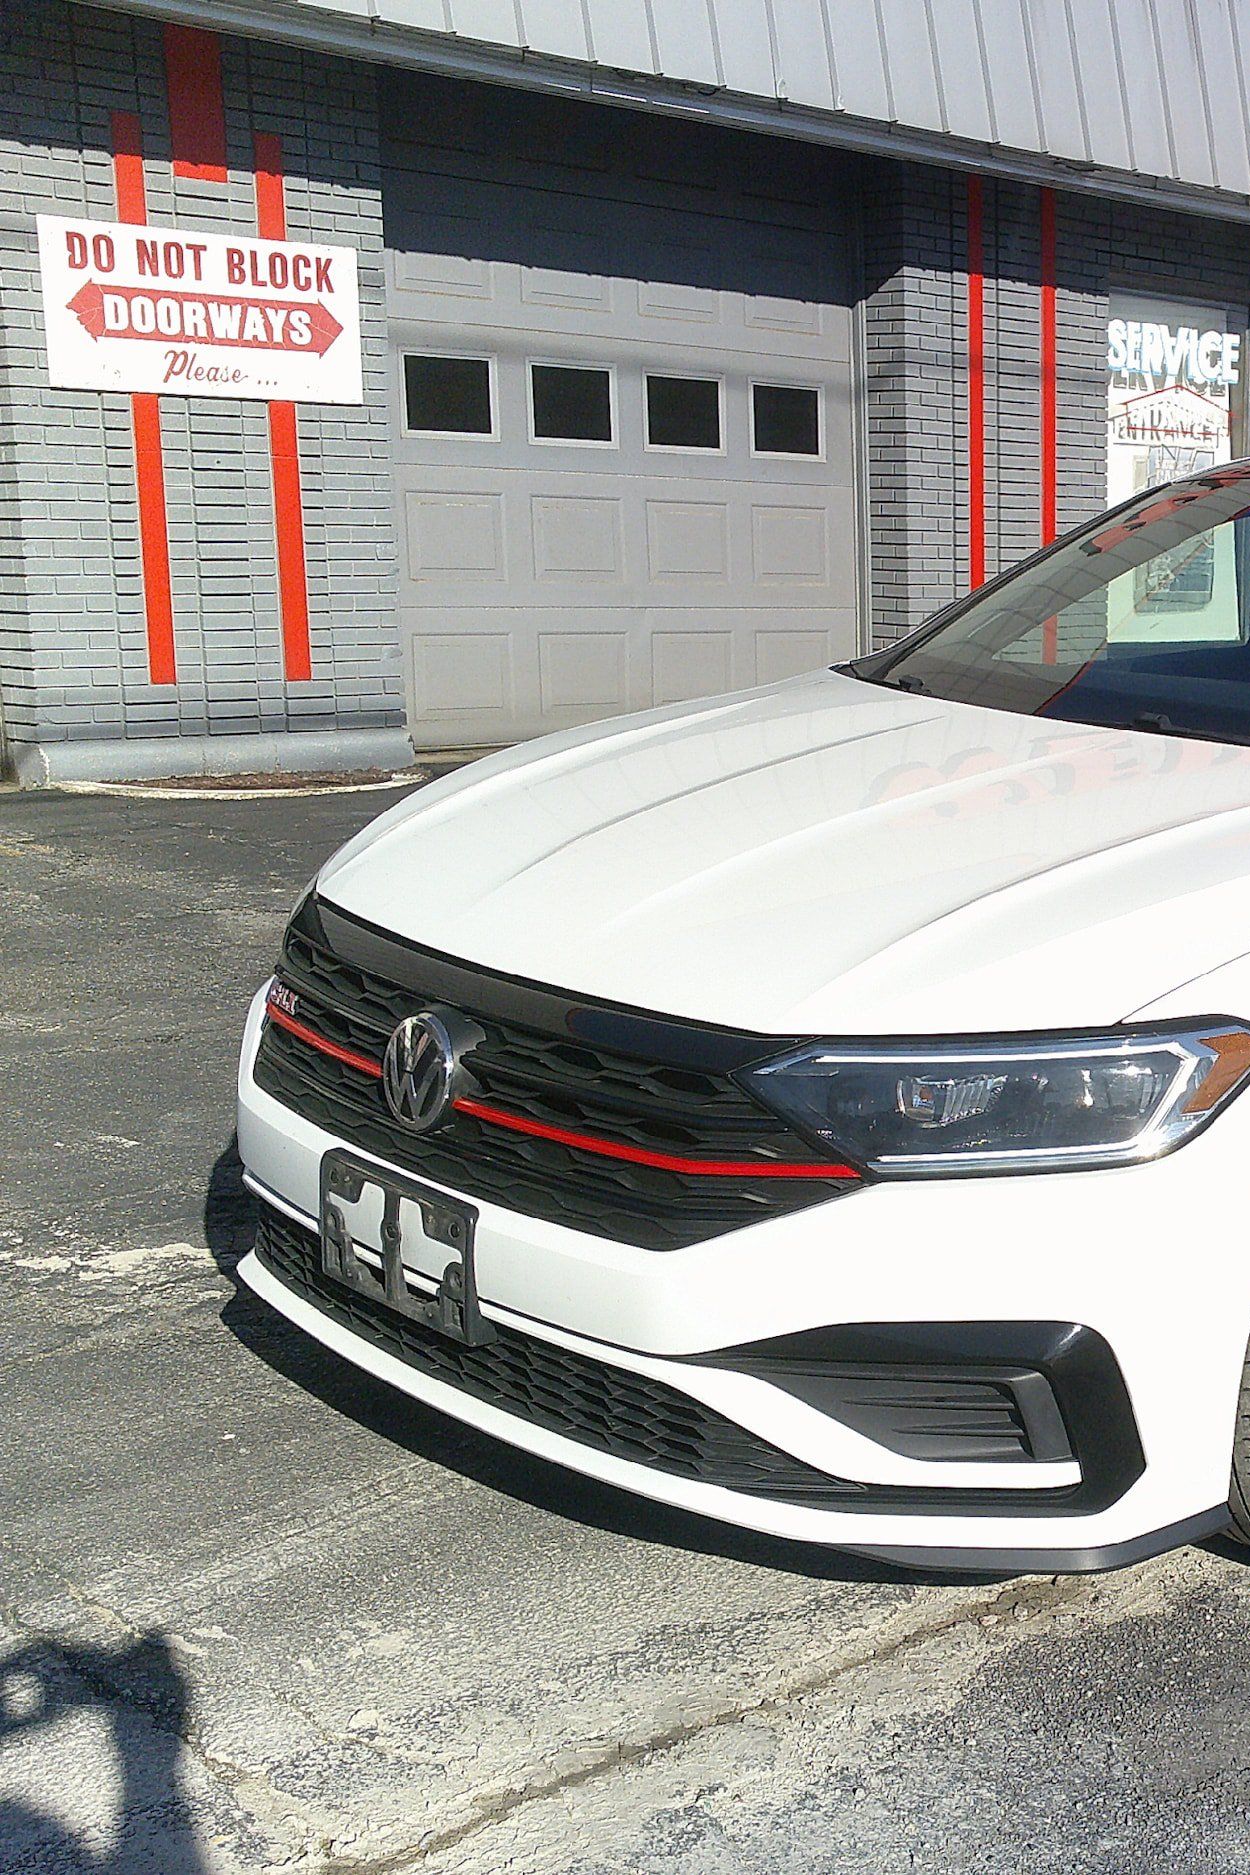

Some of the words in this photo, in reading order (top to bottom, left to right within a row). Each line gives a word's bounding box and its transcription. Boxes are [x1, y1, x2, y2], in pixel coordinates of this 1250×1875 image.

[66, 231, 116, 273] DO
[136, 239, 208, 281] NOT
[227, 248, 335, 294] BLOCK
[103, 293, 313, 347] DOORWAYS
[163, 349, 249, 384] Please
[1108, 318, 1241, 384] SERVICE
